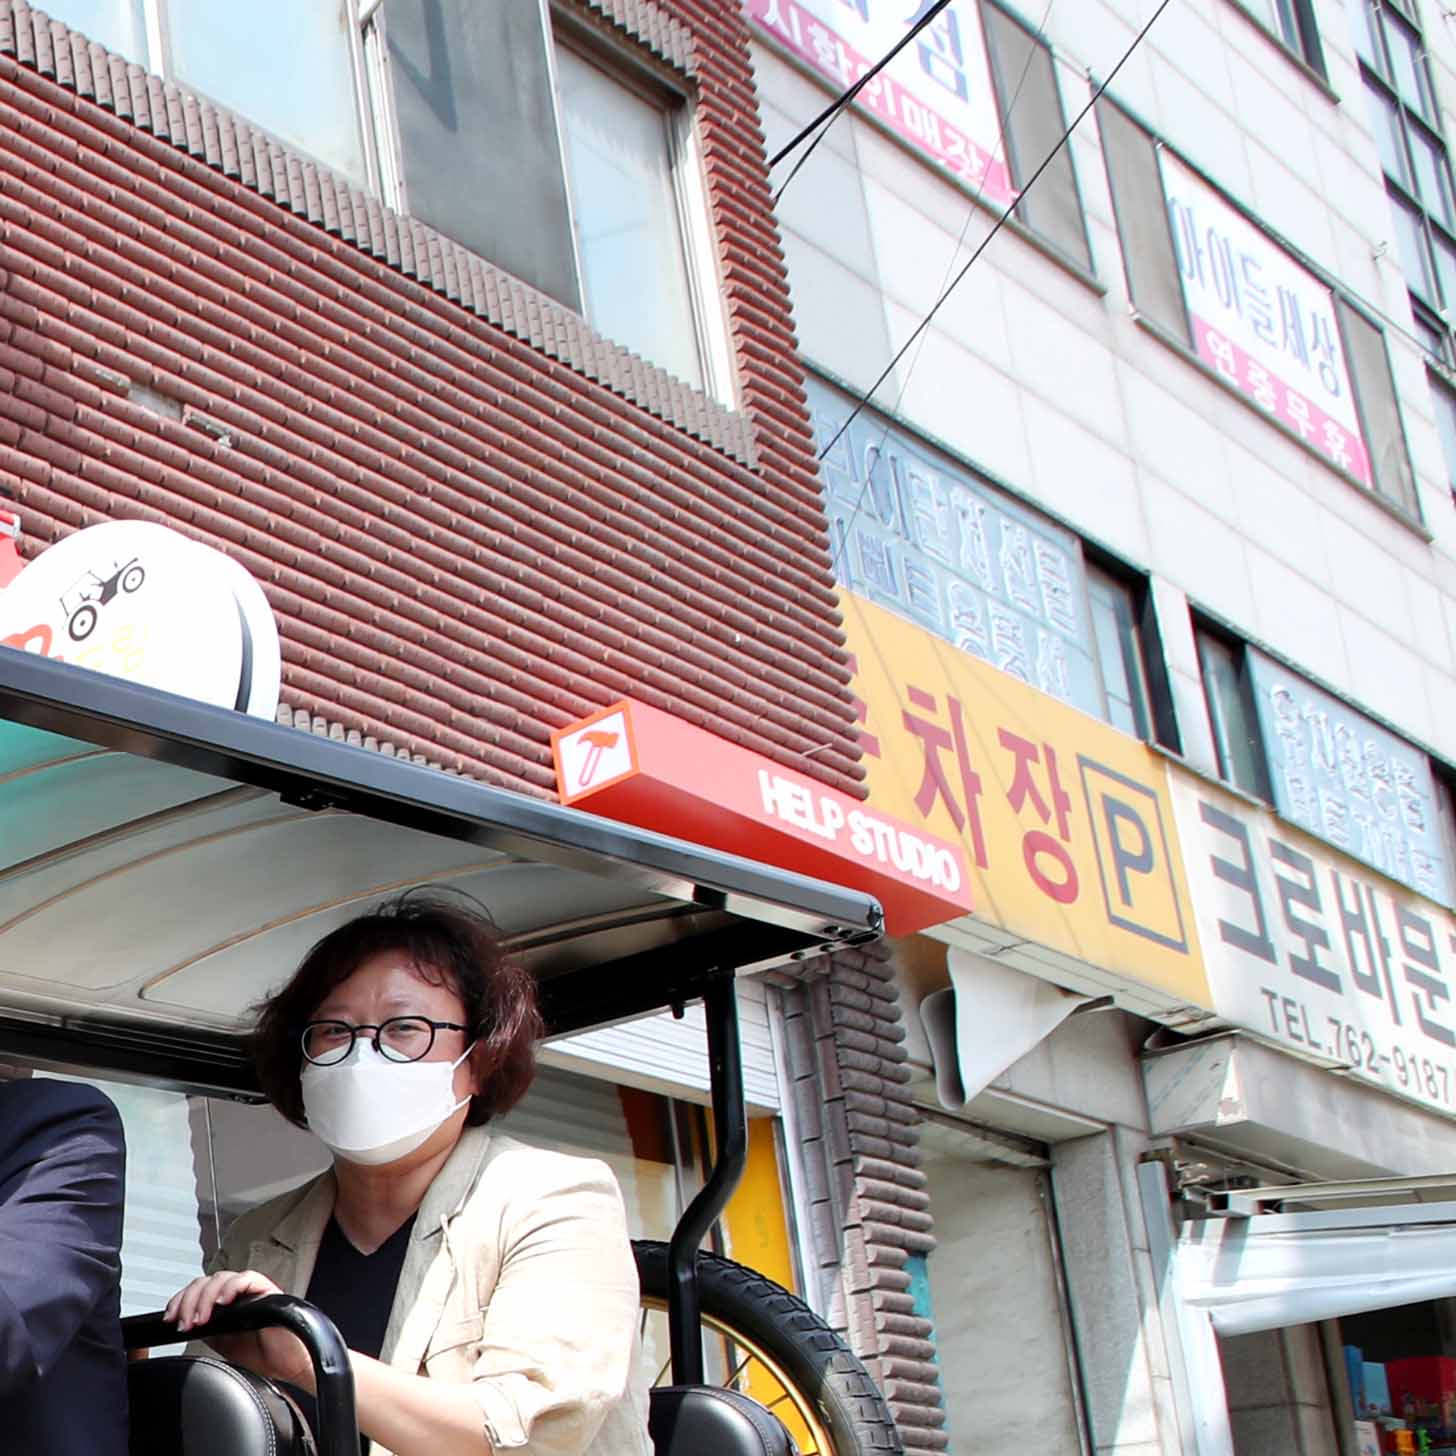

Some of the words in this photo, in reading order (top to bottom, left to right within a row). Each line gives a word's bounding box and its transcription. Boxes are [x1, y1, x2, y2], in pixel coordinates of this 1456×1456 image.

[757, 768, 845, 842] HELP
[847, 809, 961, 893] STUDIO
[845, 653, 1080, 905] 차장
[1101, 792, 1155, 907] P
[1198, 799, 1456, 1049] 크로바문
